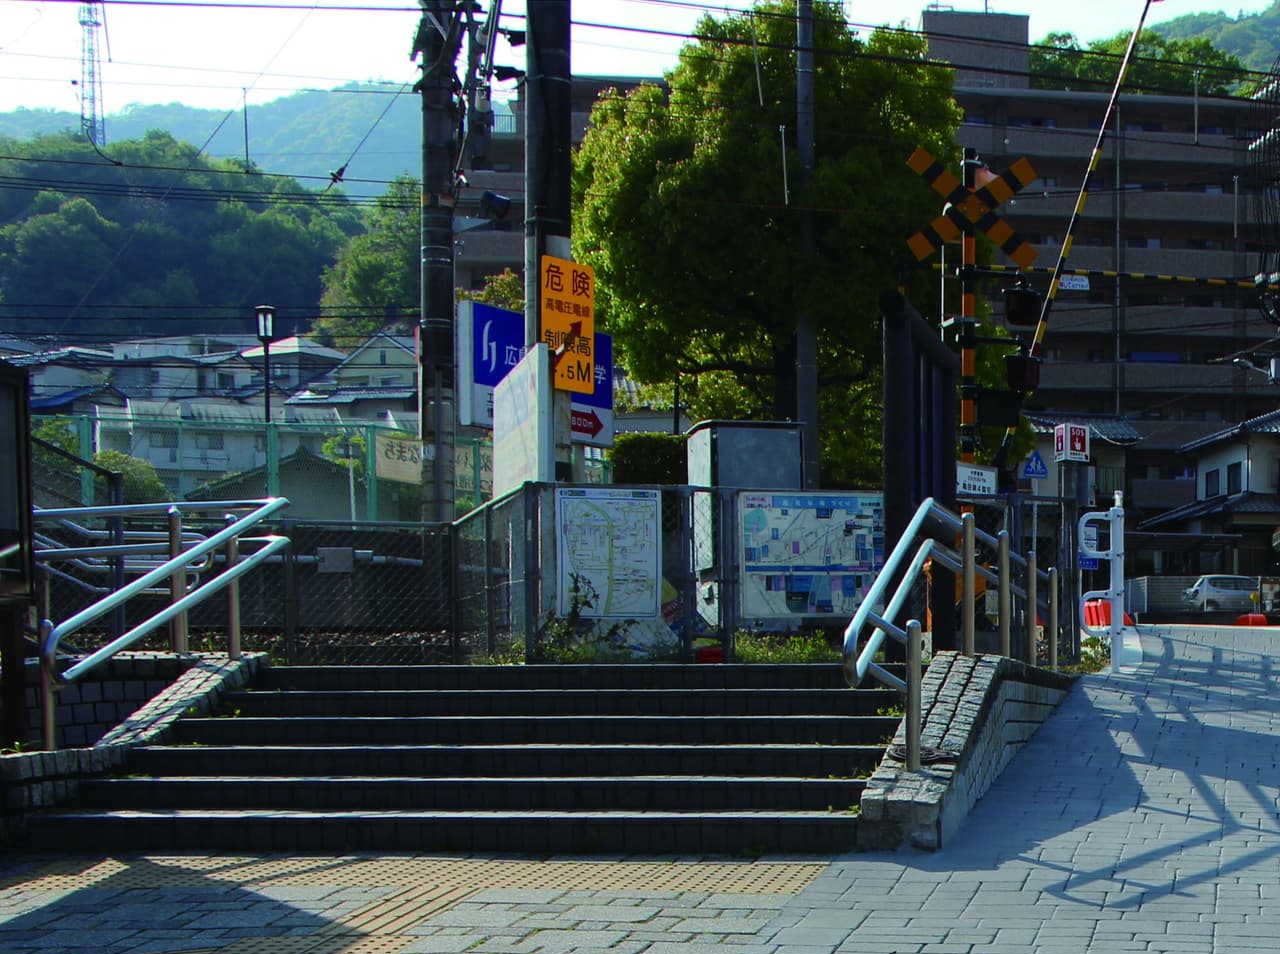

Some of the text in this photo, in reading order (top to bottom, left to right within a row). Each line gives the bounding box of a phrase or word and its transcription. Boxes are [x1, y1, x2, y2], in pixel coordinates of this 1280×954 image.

[545, 263, 591, 298] 危険
[553, 360, 591, 383] .5M
[1071, 428, 1085, 437] SOS
